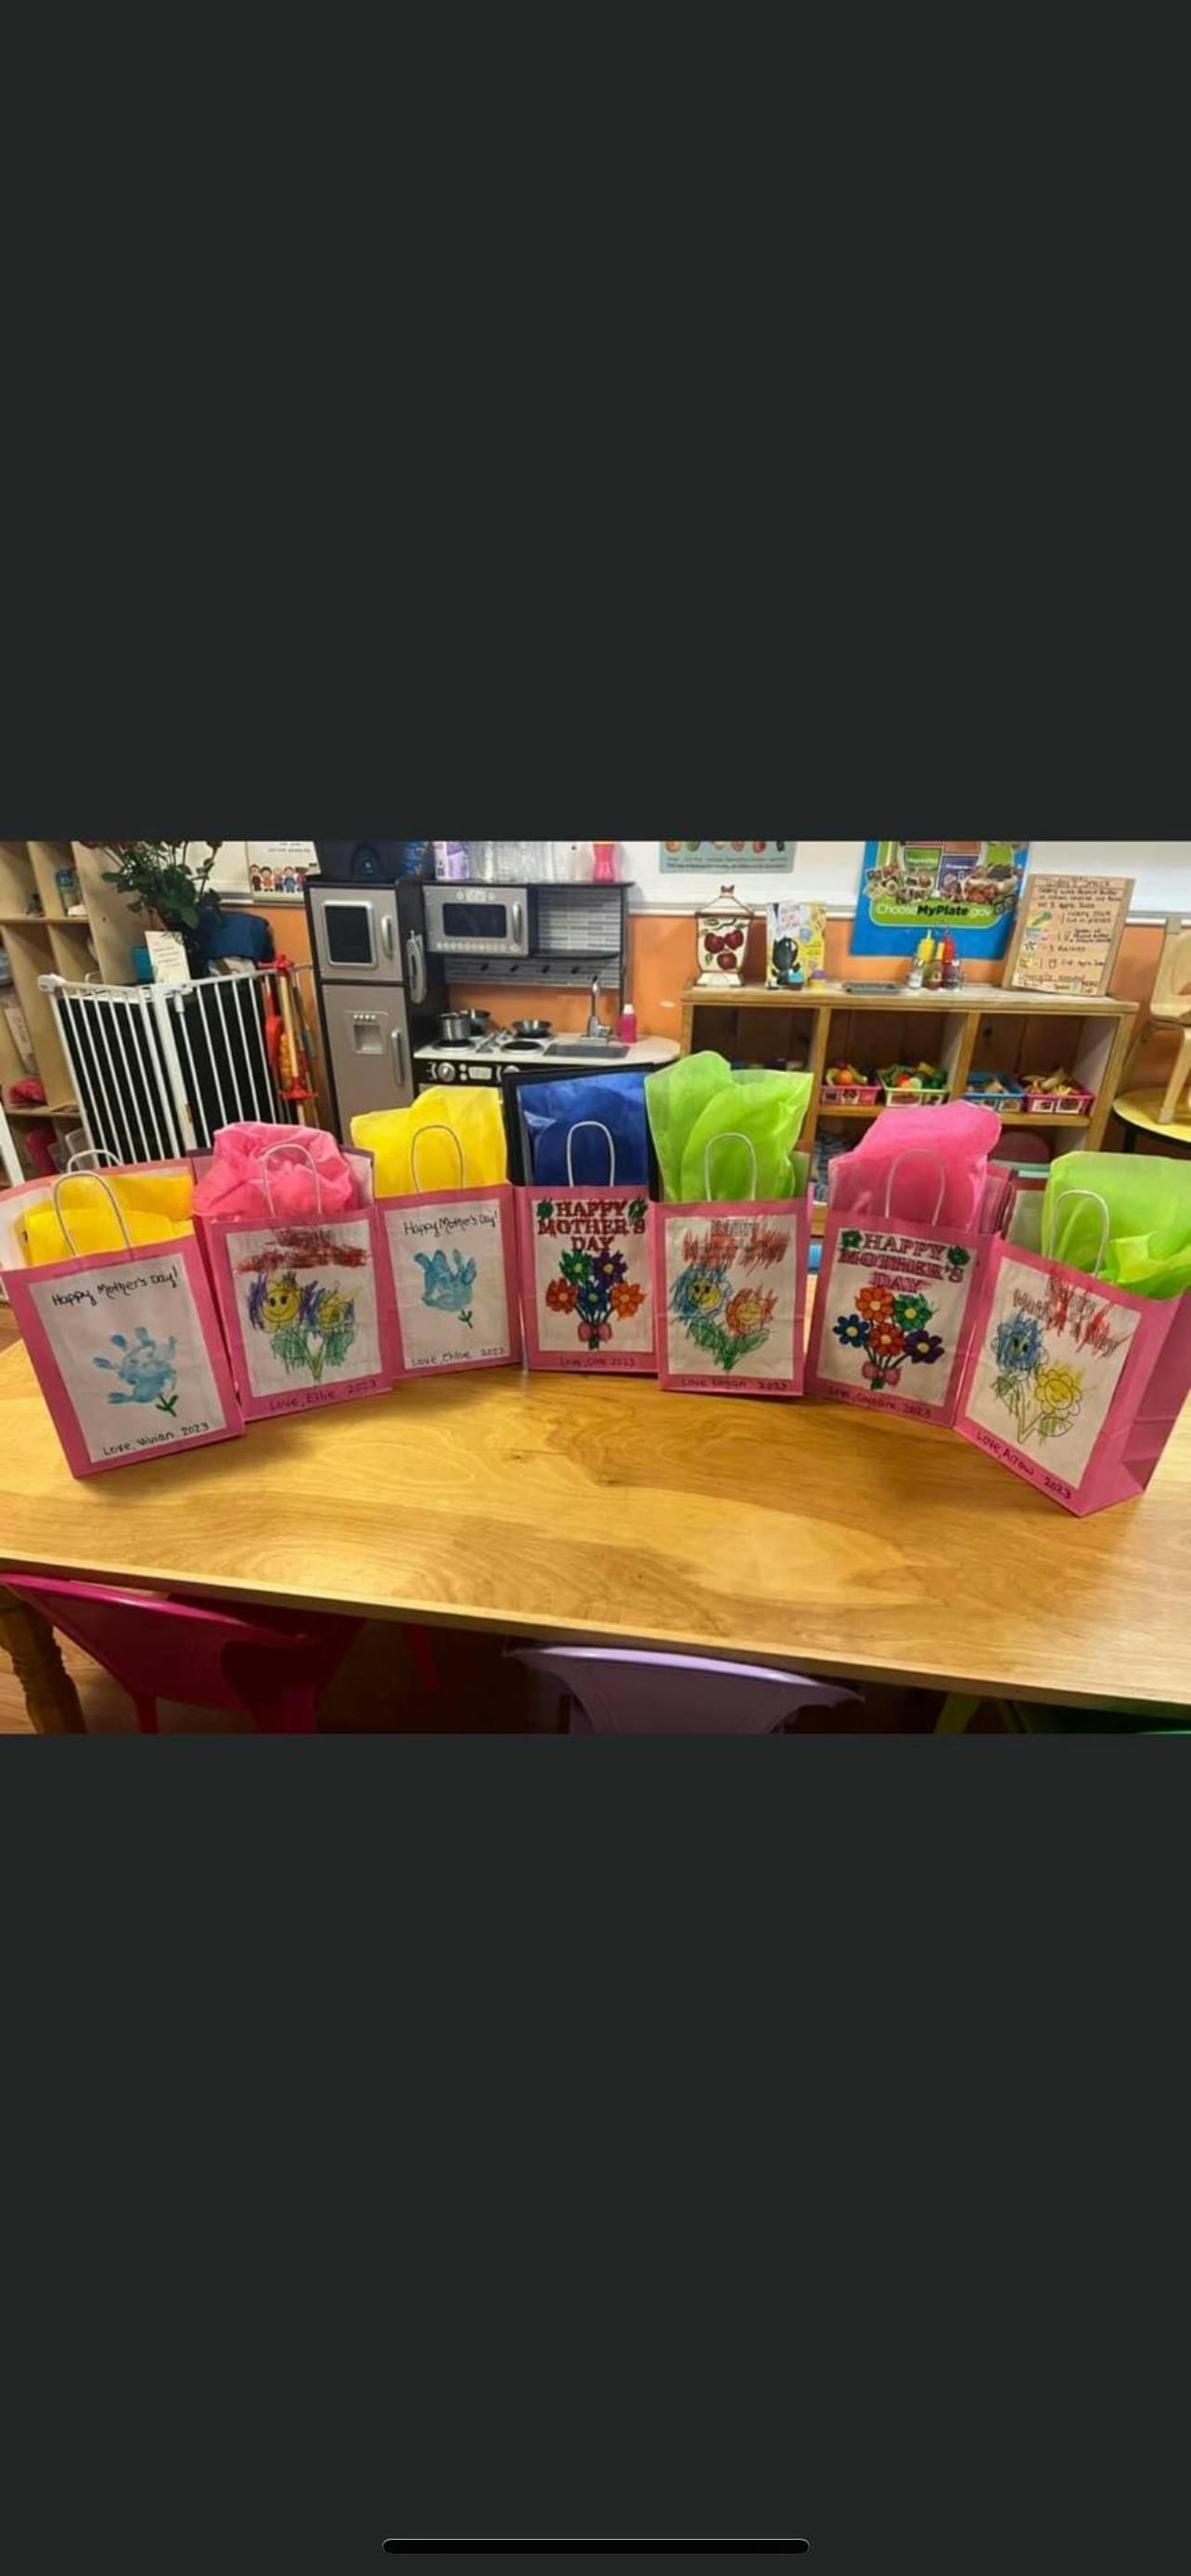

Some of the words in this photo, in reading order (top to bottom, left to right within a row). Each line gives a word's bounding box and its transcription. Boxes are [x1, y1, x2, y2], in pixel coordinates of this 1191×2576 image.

[556, 1201, 628, 1218] HAPPY
[403, 1220, 441, 1238] Happy
[570, 1235, 615, 1252] DAY
[862, 1232, 946, 1260] HAPPY
[837, 1247, 965, 1283] MOTHER'S
[51, 1290, 97, 1307] Happy
[96, 1278, 147, 1299] Mother's
[870, 1271, 926, 1294] DAY
[181, 1422, 211, 1436] 2023
[1044, 1476, 1071, 1499] 2023
